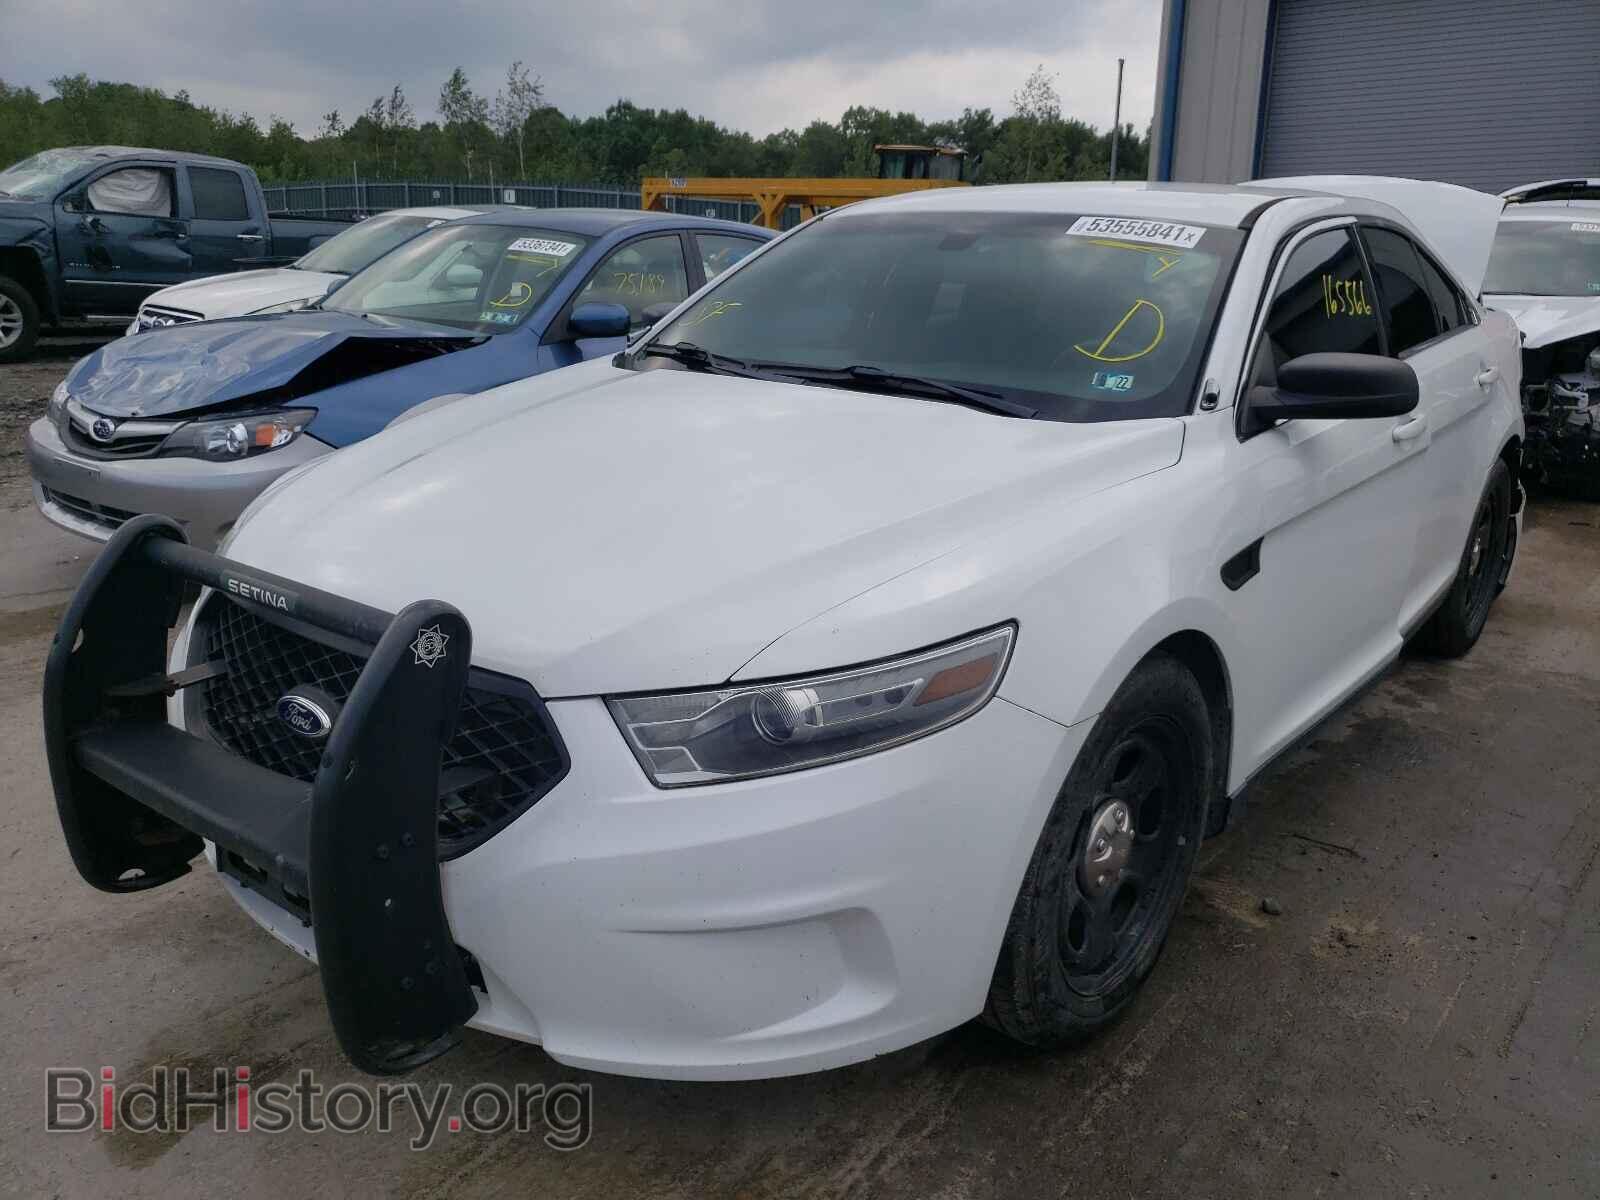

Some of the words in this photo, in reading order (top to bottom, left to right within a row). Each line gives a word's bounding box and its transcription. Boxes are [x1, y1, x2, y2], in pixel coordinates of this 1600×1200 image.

[1086, 217, 1186, 242] 53555841
[1322, 274, 1373, 319] 165566
[1073, 298, 1166, 363] D
[227, 578, 289, 612] SETINA
[287, 702, 314, 731] Ford
